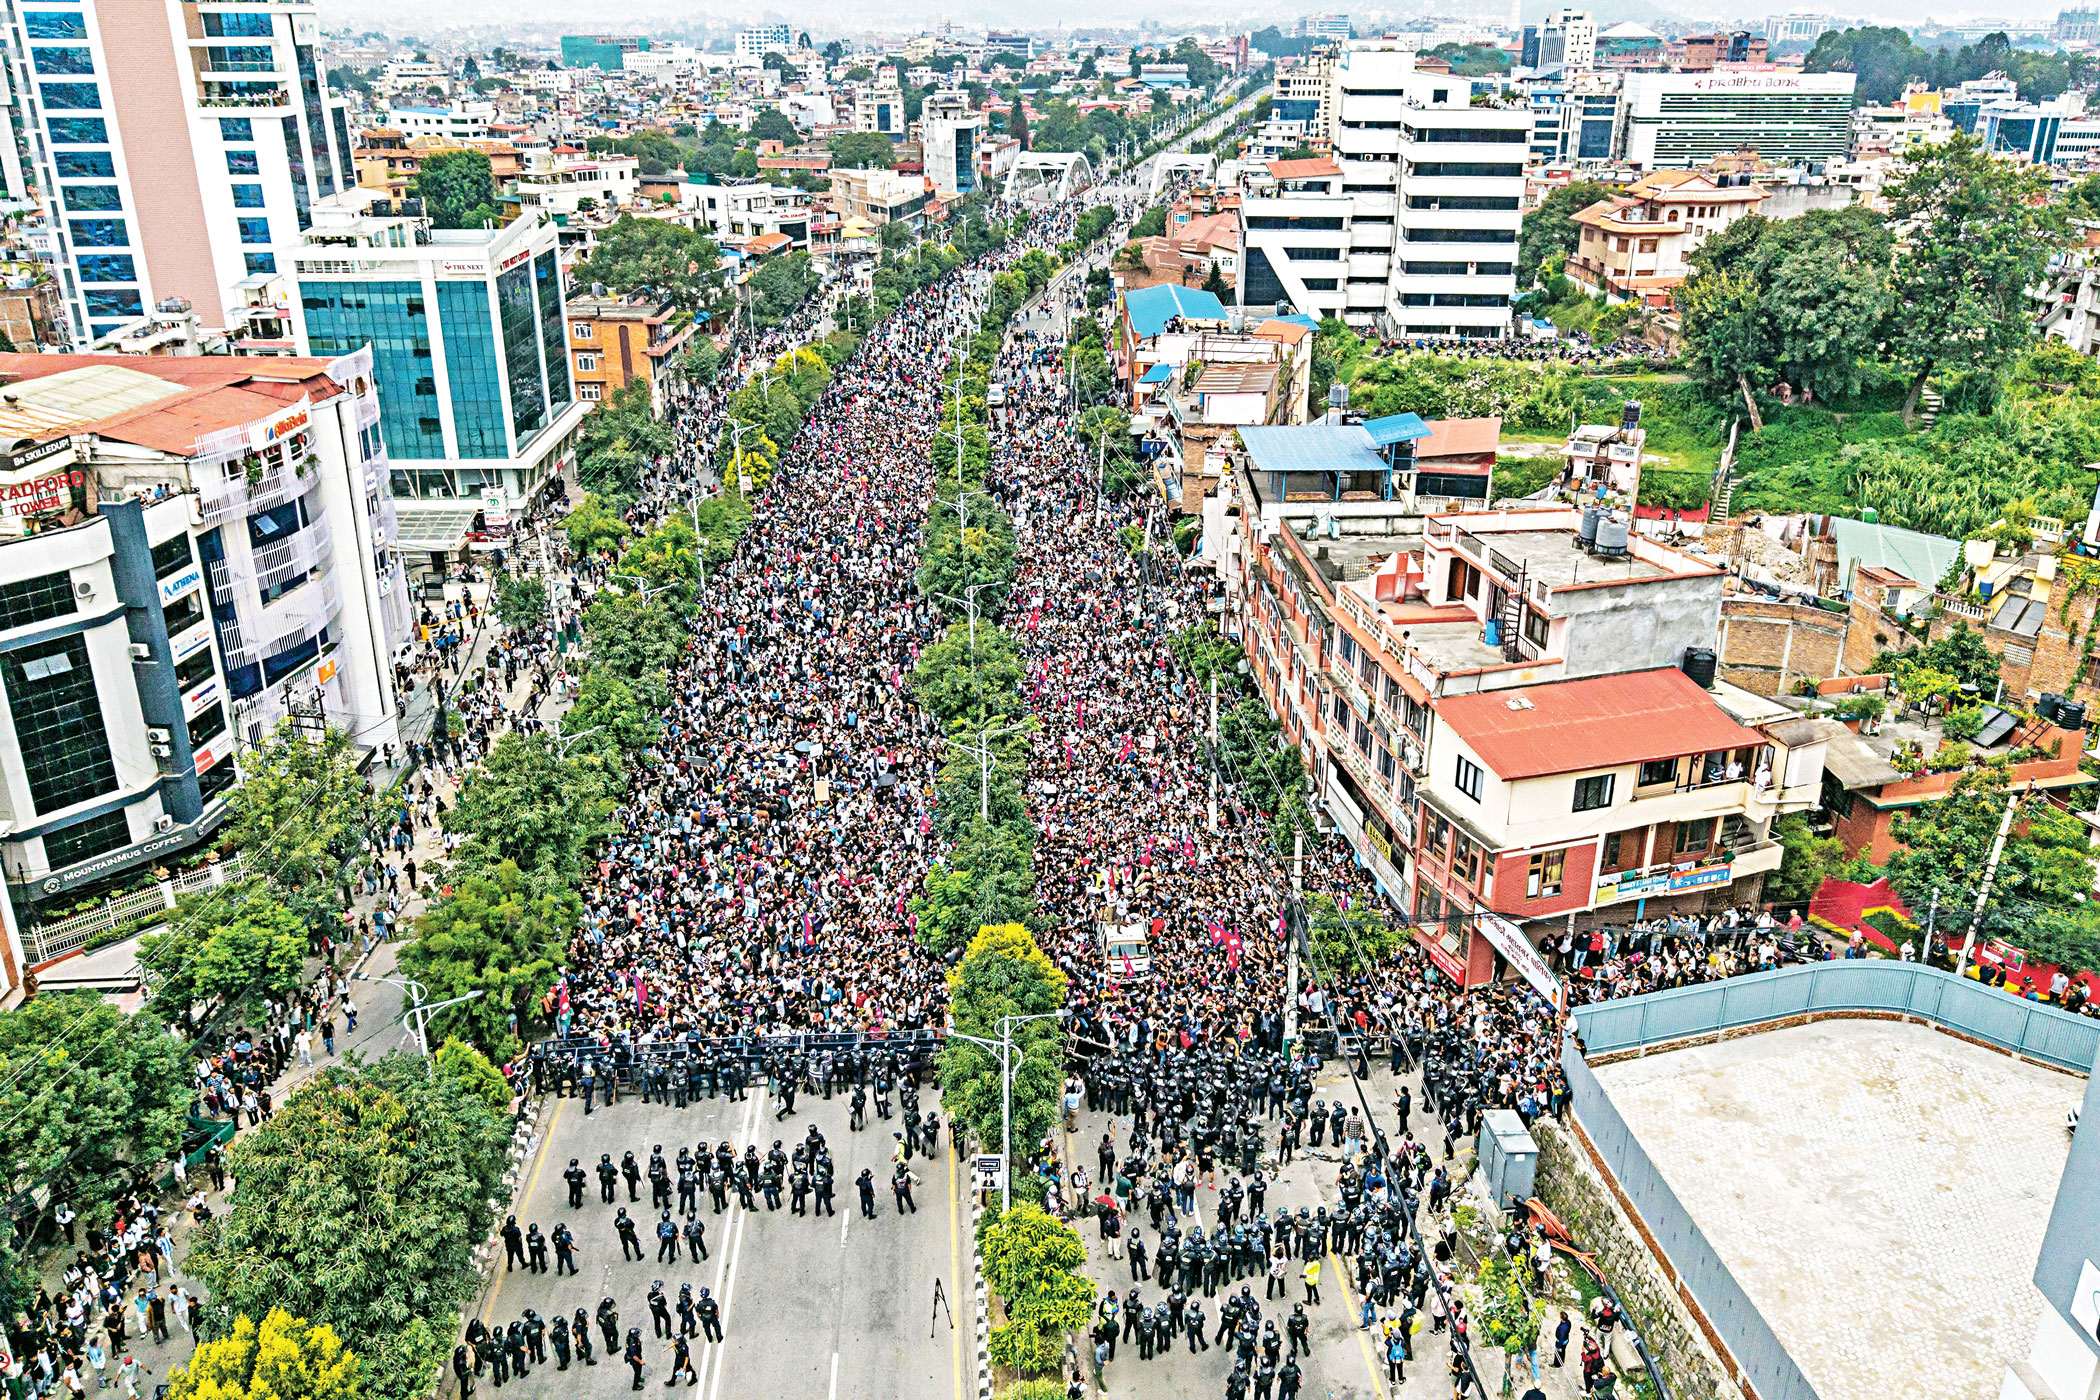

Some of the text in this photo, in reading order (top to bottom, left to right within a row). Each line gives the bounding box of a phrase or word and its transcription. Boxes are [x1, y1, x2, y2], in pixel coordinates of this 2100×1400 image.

[13, 455, 24, 466] Be
[12, 495, 62, 516] TOWER
[172, 570, 201, 592] ATHENA
